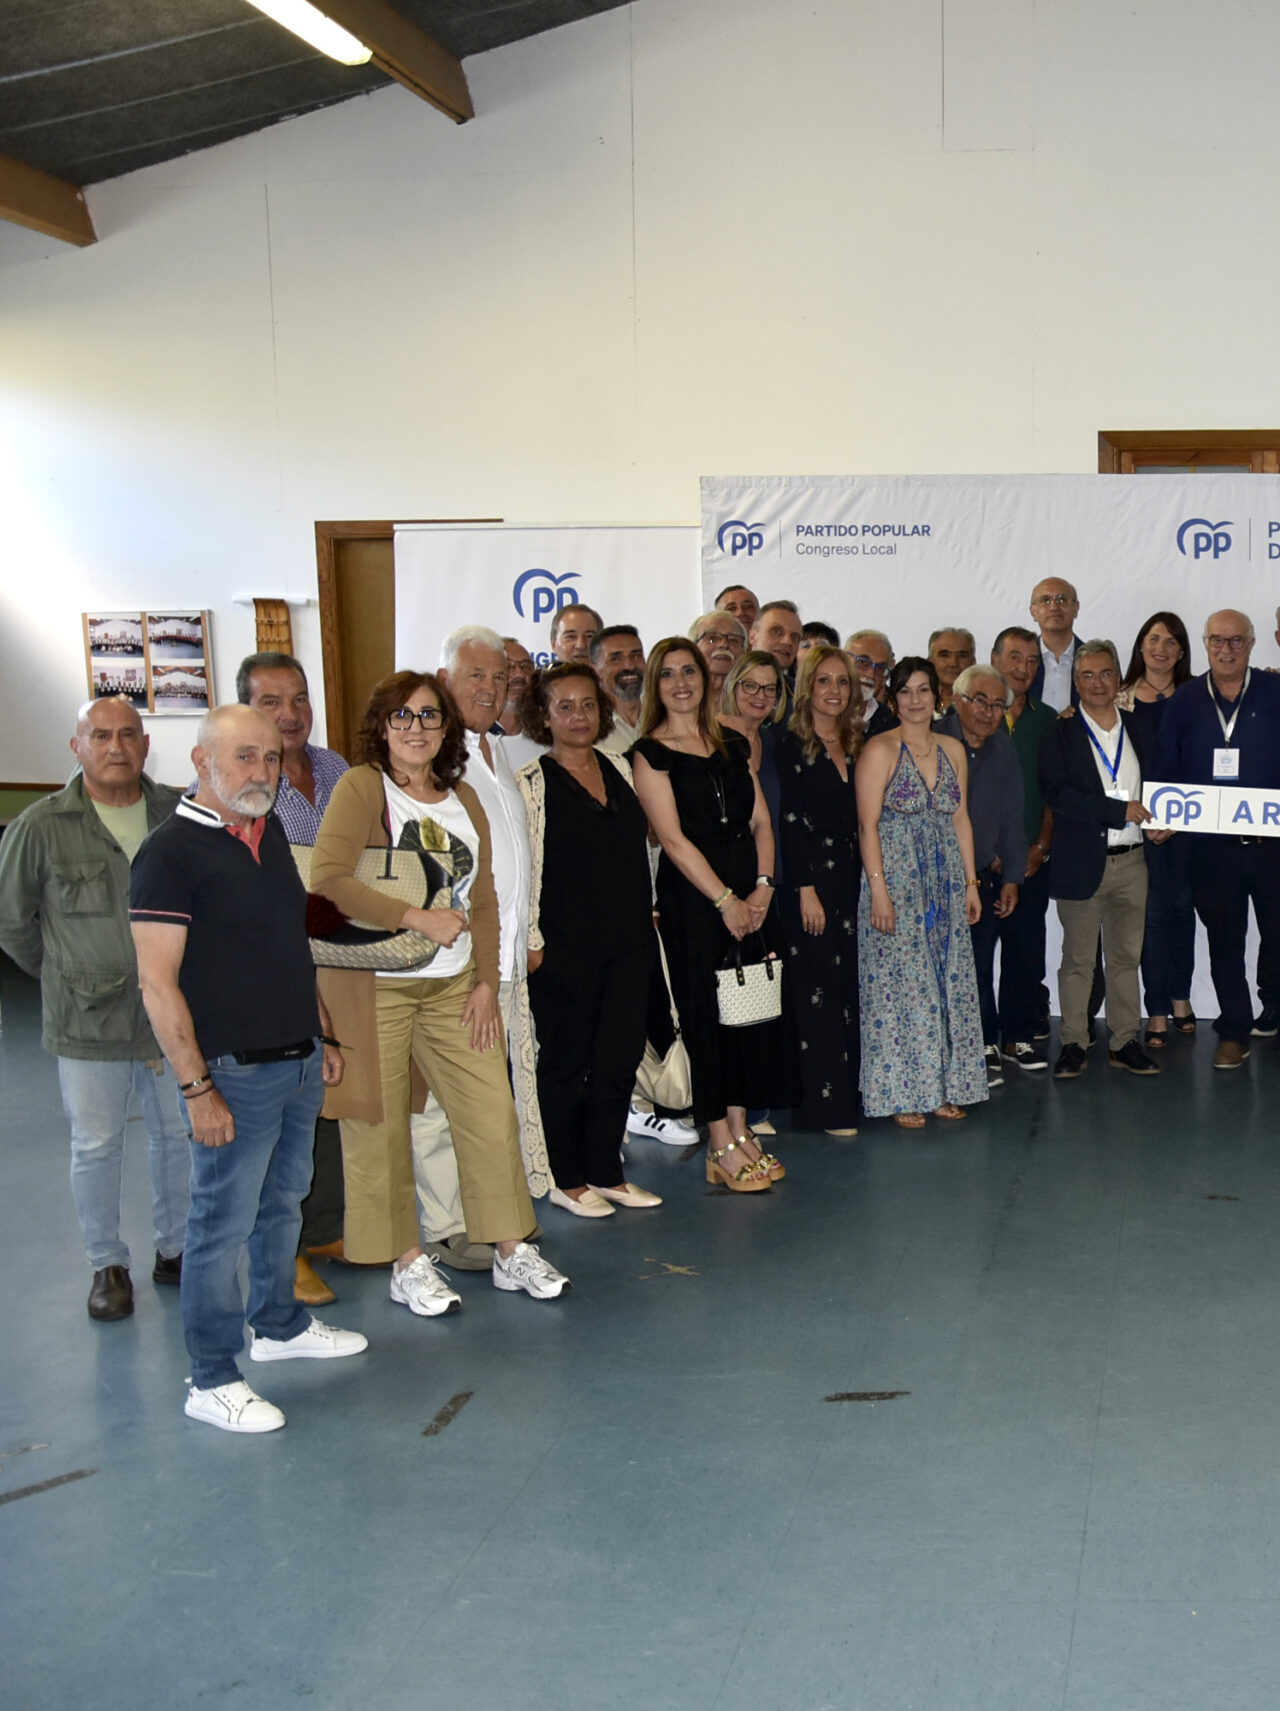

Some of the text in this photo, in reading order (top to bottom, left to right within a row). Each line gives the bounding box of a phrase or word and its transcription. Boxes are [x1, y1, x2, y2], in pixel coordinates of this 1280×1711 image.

[795, 525, 931, 537] PARTIDO POPULAR
[795, 543, 897, 558] Congreso Local
[1232, 800, 1254, 824] A
